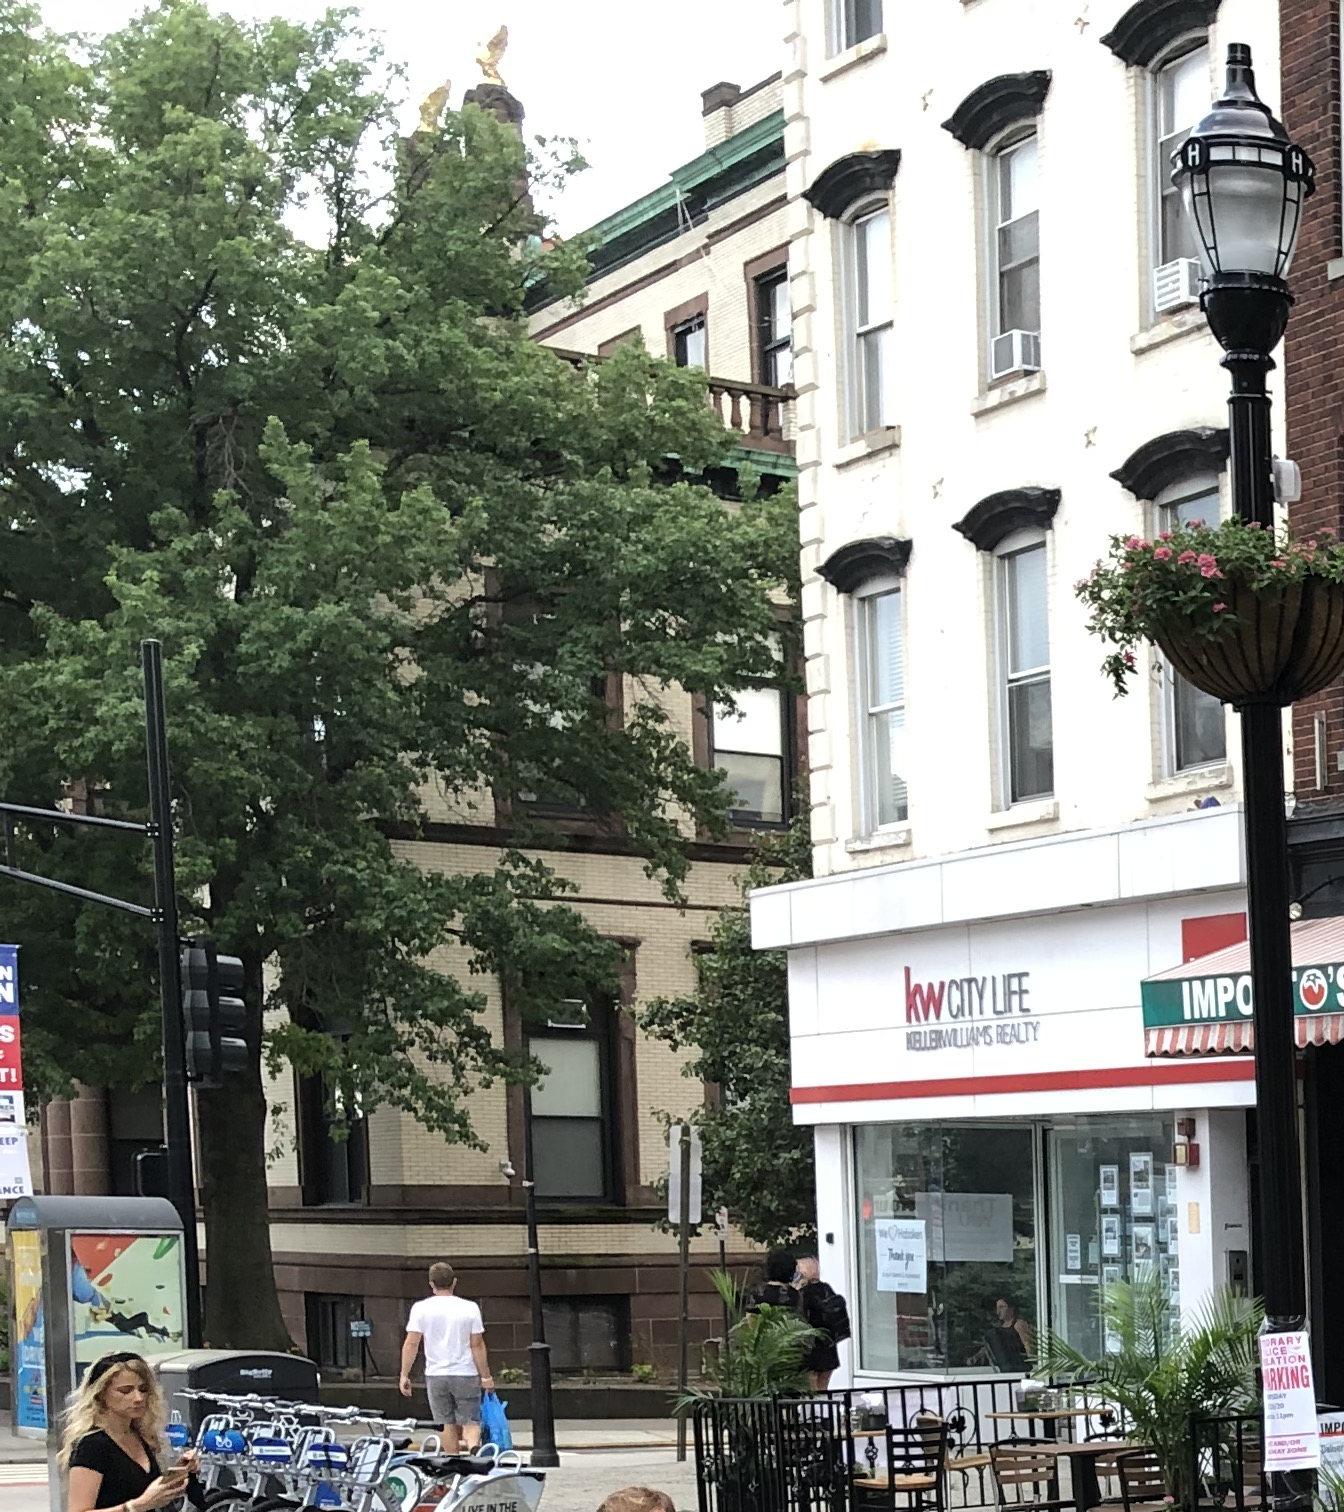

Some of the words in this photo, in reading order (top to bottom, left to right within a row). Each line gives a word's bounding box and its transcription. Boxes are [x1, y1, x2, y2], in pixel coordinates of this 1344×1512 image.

[1188, 143, 1200, 167] H
[1291, 151, 1303, 175] H
[904, 966, 946, 1024] kw
[947, 976, 987, 1019] CITY
[991, 972, 1031, 1015] LIFE
[996, 1021, 1041, 1045] REALTY
